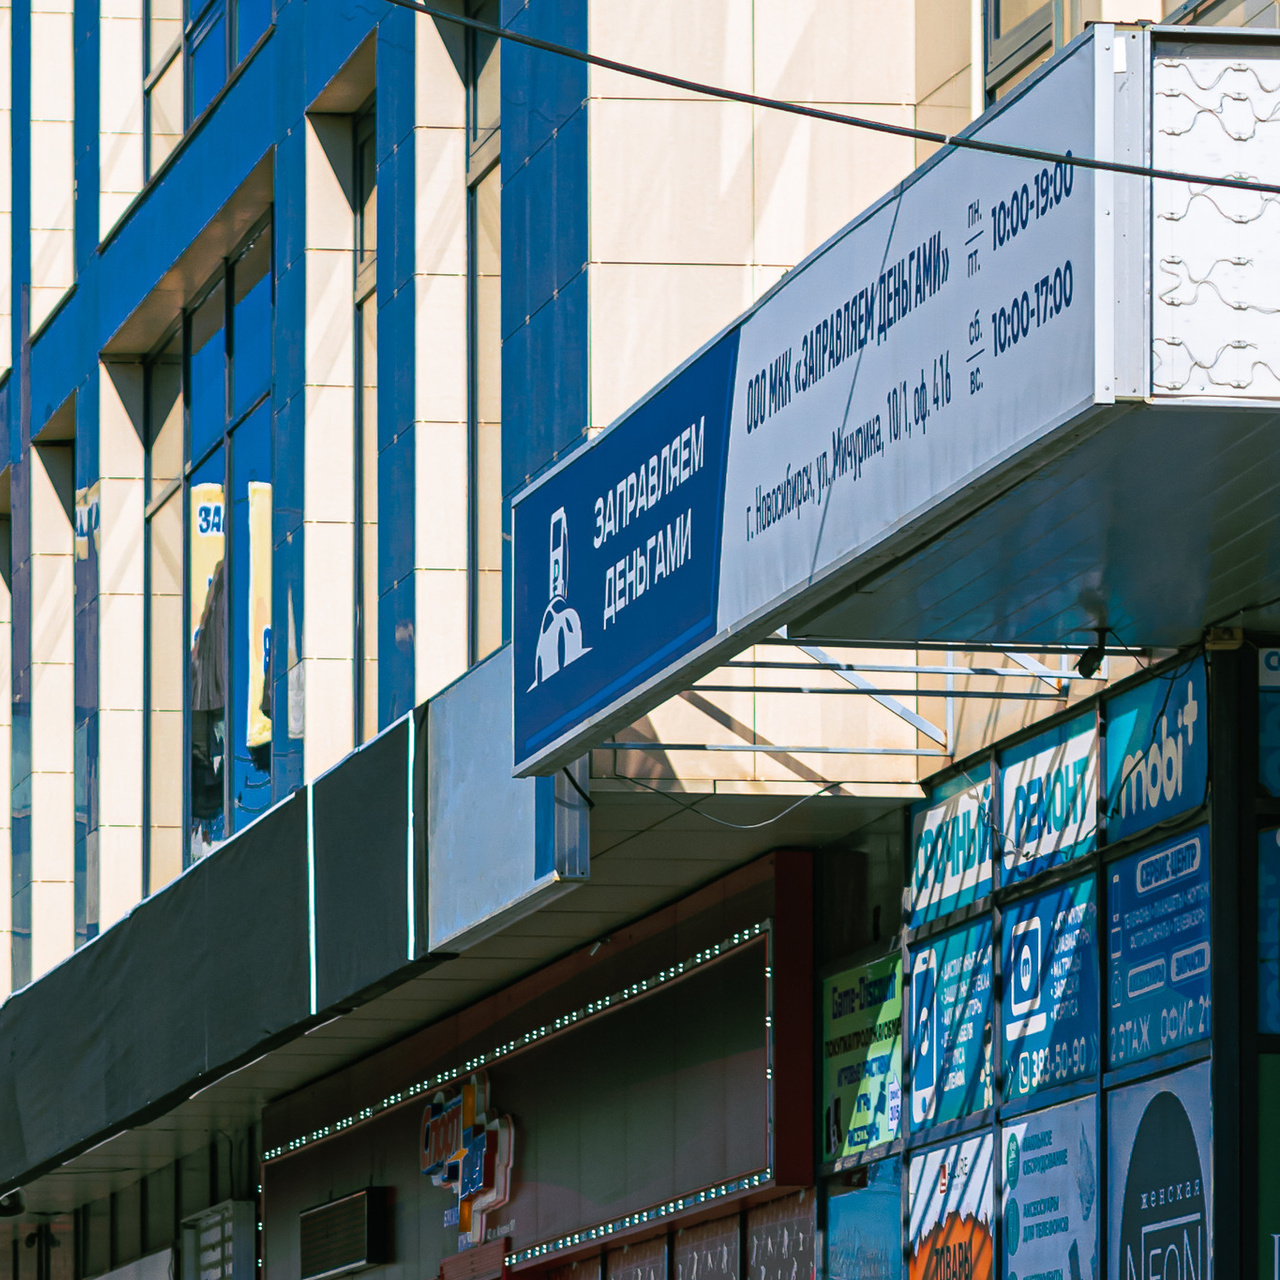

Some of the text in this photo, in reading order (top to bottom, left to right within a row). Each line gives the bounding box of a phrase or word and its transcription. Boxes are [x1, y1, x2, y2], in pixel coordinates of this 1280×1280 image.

[991, 150, 1074, 251] 10:00-19:00
[747, 369, 766, 434] ООО
[794, 282, 875, 394] «ЗАПРАВЛЯЕМ
[877, 230, 950, 346] ДЕНЬГАМИ»
[992, 260, 1074, 357] 10:00-17:00
[593, 415, 705, 549] ЗАПРАВЛЯЕМ
[755, 463, 815, 520] Новосибирск,
[831, 414, 885, 481] Мичурина,
[914, 368, 931, 434] оф.
[933, 350, 952, 411] 416
[603, 508, 692, 630] ДЕНЬГАМИ
[1014, 756, 1088, 848] РЕМОНТ
[1118, 1014, 1151, 1059] ЭТАЖ
[1161, 999, 1195, 1046] ОФИС
[1141, 1178, 1200, 1209] женская
